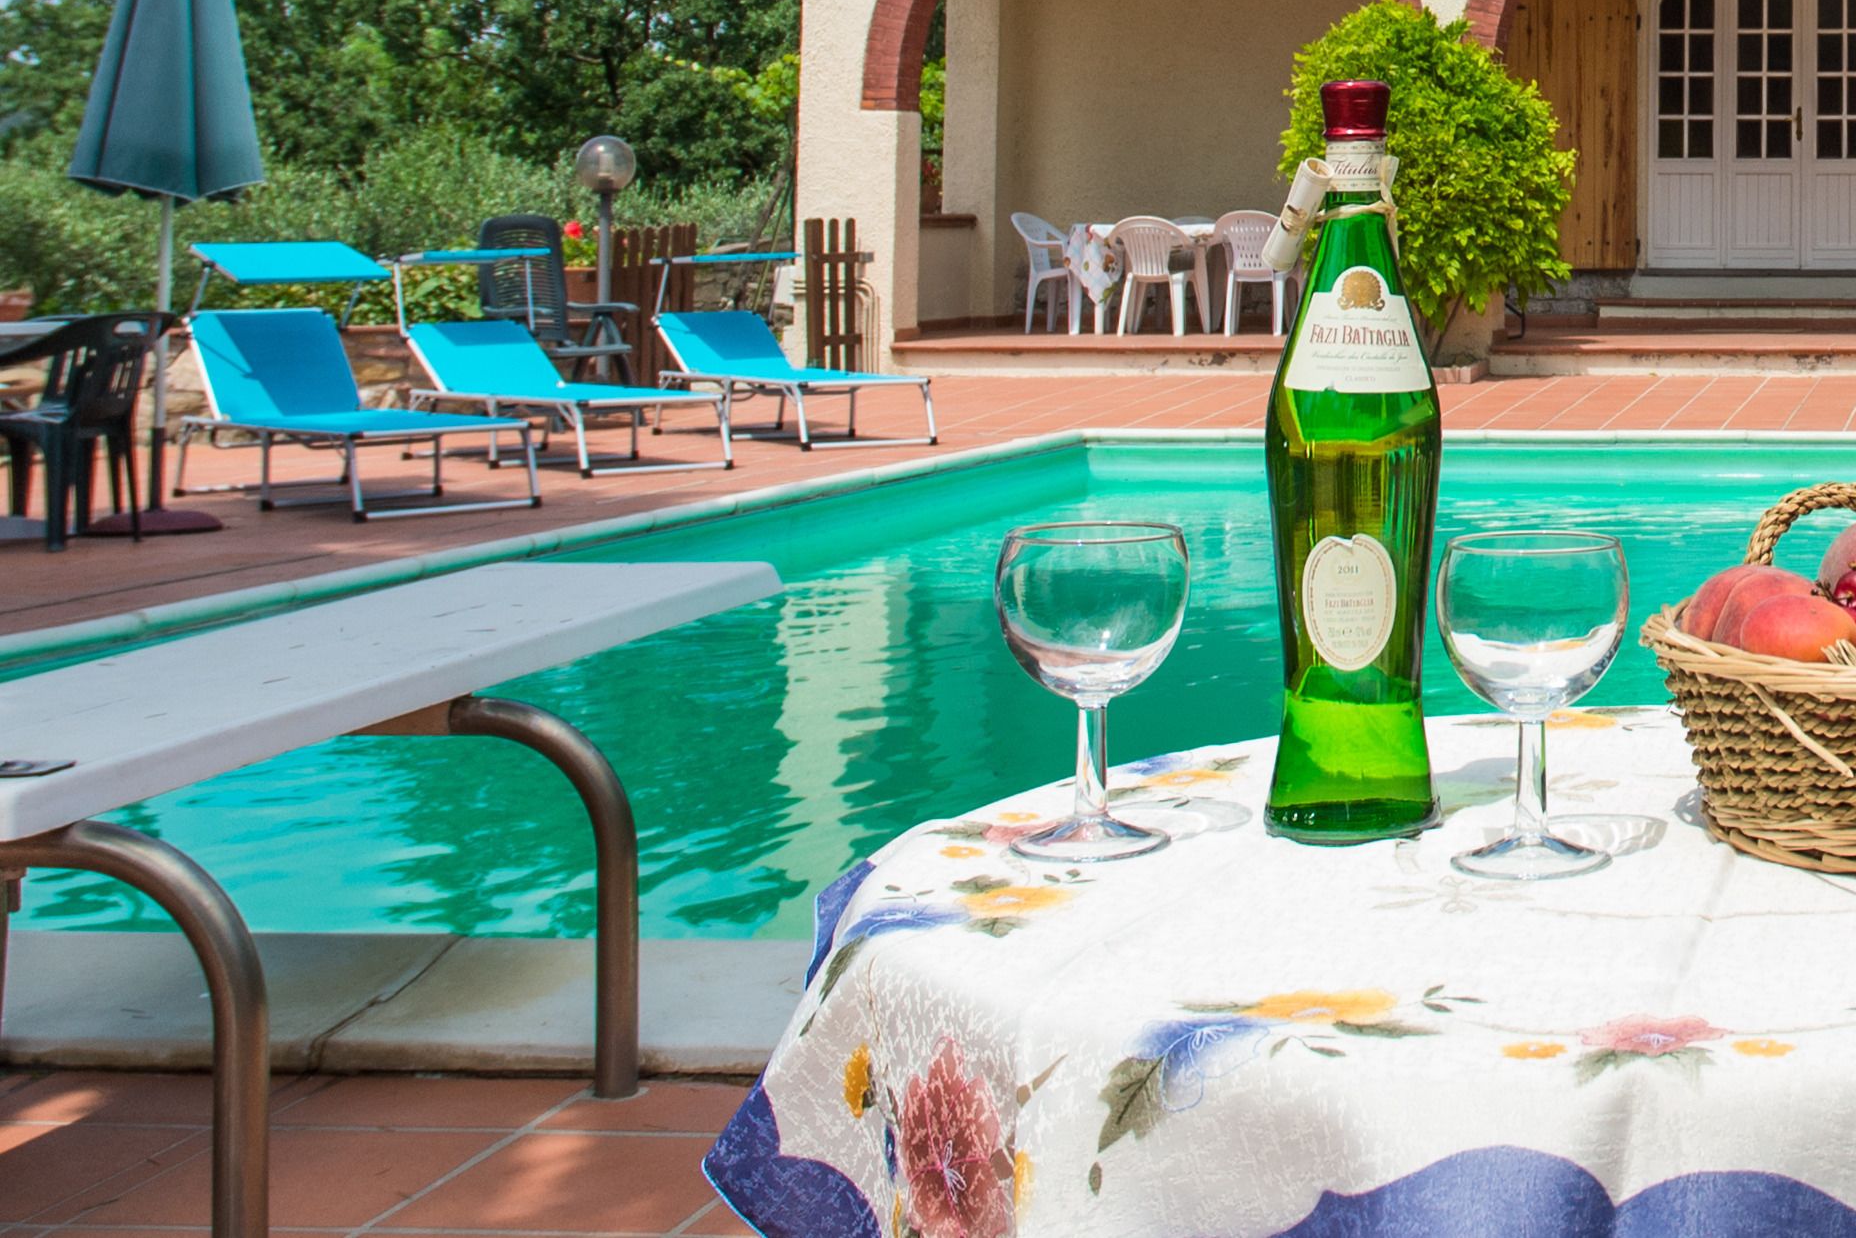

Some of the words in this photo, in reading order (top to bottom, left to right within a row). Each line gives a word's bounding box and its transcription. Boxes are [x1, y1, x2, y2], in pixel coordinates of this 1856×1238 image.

[1330, 154, 1378, 175] Titulus
[1309, 323, 1338, 344] FAZI
[1342, 324, 1411, 347] BATTAGLIA
[1337, 565, 1359, 574] 2011
